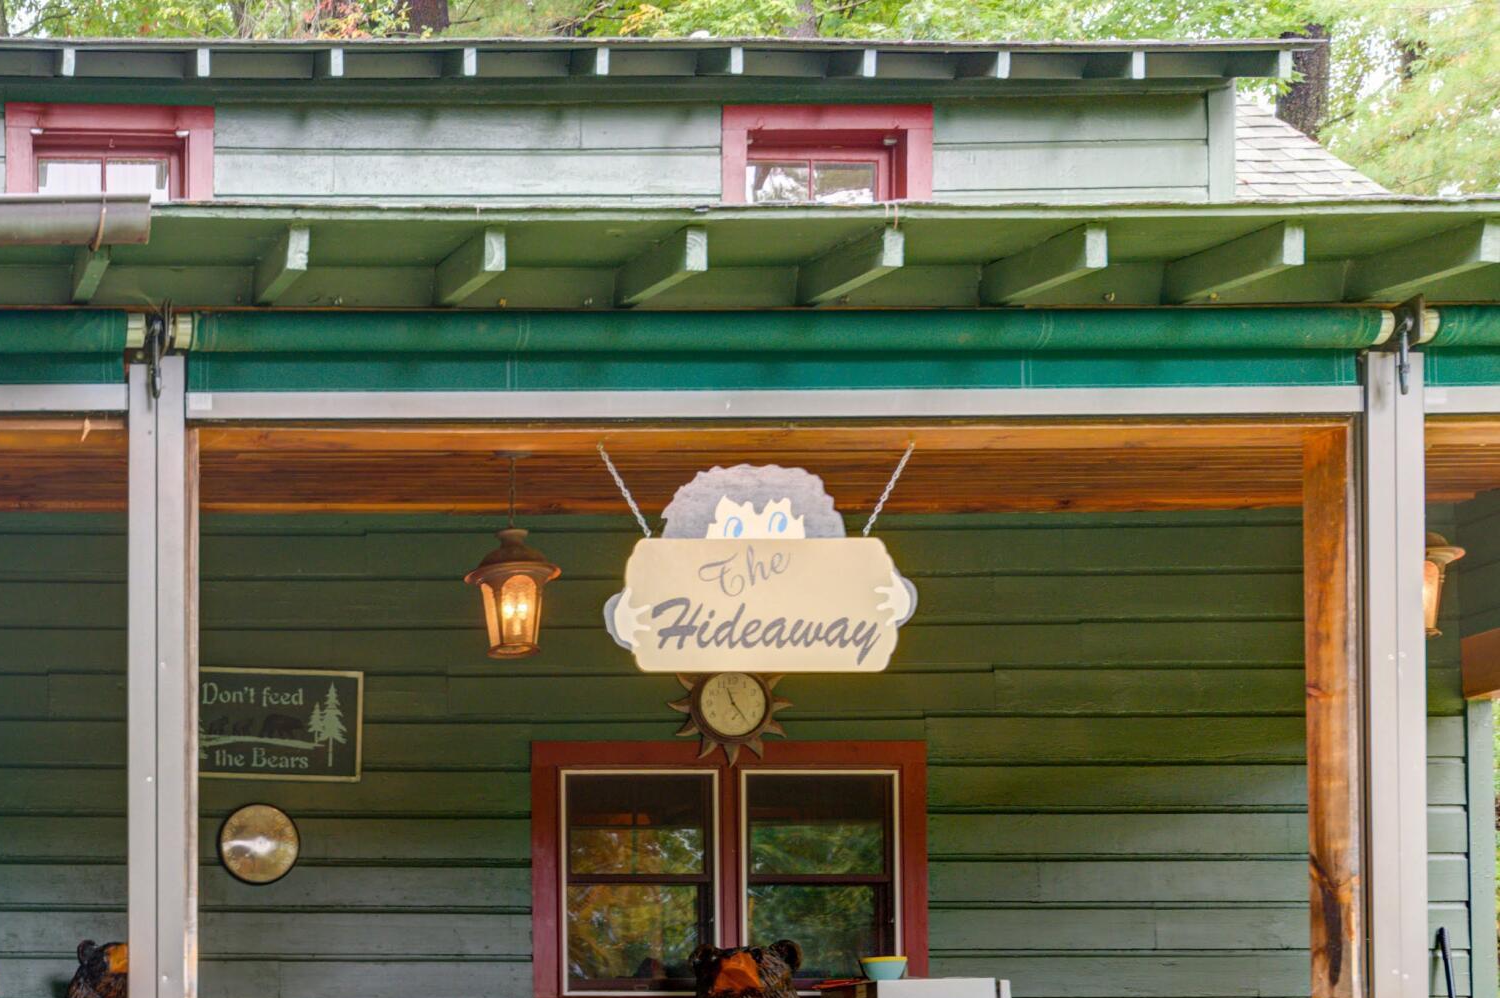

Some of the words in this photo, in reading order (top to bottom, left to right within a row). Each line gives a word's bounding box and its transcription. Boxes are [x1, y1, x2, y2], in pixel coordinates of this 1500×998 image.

[698, 544, 791, 597] The
[651, 598, 882, 666] Hideaway
[202, 682, 255, 705] Don't
[262, 687, 304, 707] feed
[215, 750, 245, 767] the
[252, 748, 309, 769] Bears
